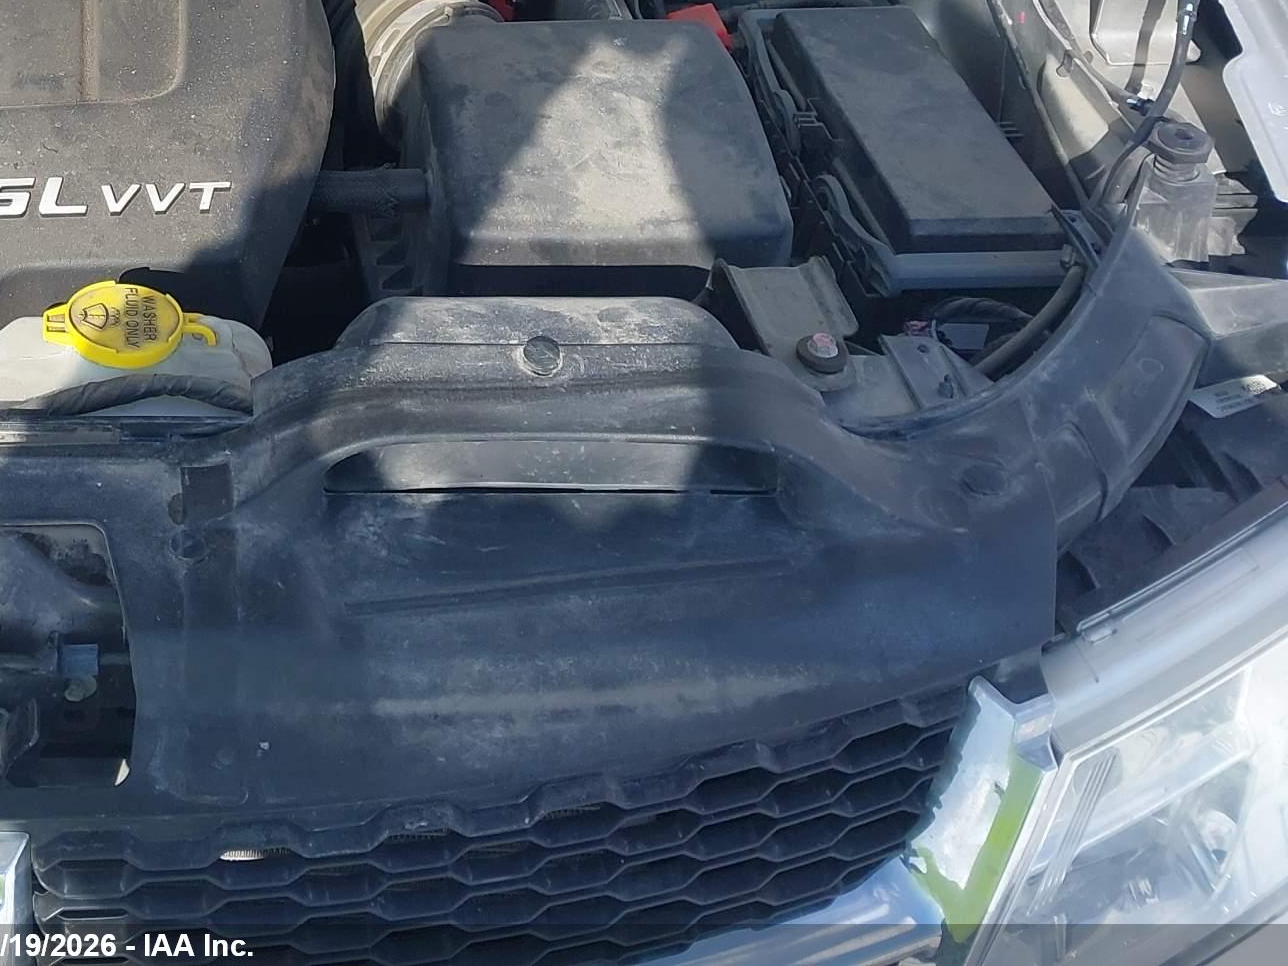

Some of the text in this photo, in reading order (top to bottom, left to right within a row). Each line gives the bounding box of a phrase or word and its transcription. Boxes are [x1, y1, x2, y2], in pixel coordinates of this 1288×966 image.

[101, 181, 232, 215] VVT
[124, 287, 140, 348] FLUID ONLY
[142, 295, 157, 342] WASHER
